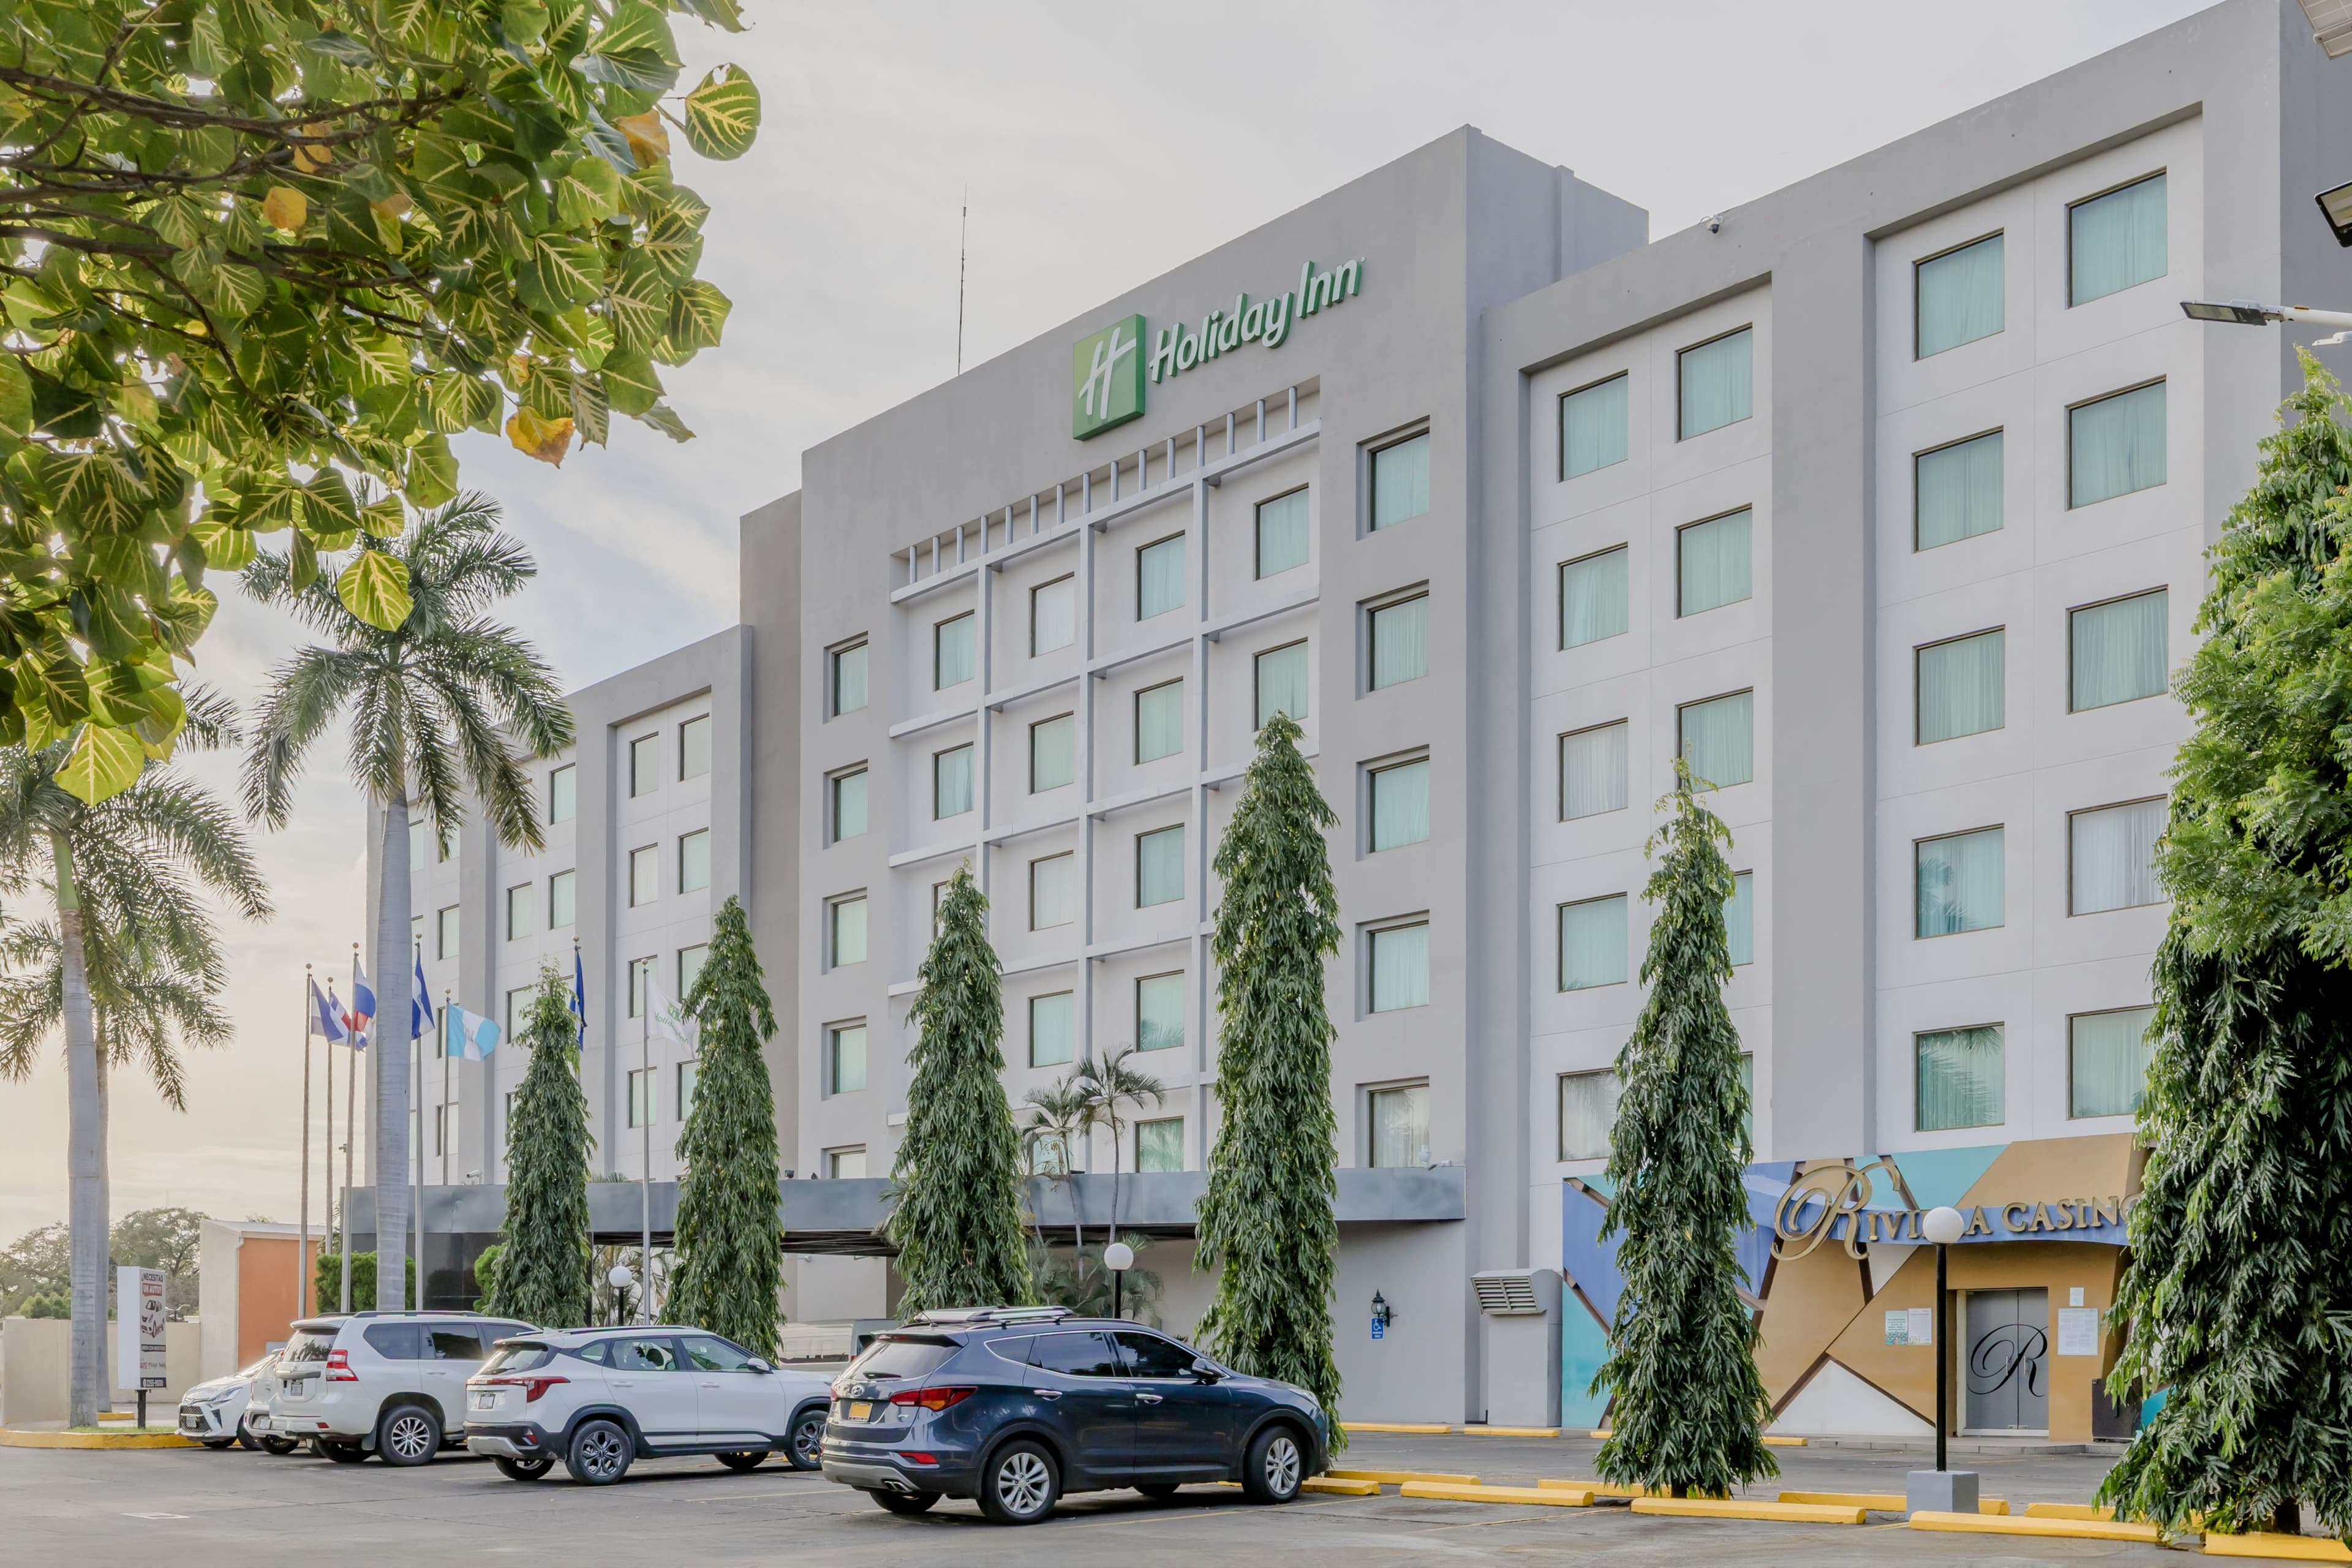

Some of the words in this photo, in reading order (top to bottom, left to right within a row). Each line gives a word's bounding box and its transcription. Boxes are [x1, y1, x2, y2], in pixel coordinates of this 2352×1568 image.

[1149, 292, 1294, 383] Holiday
[1295, 260, 1362, 319] Inn
[1770, 1161, 1993, 1261] RIVIA
[1967, 1324, 2049, 1397] R
